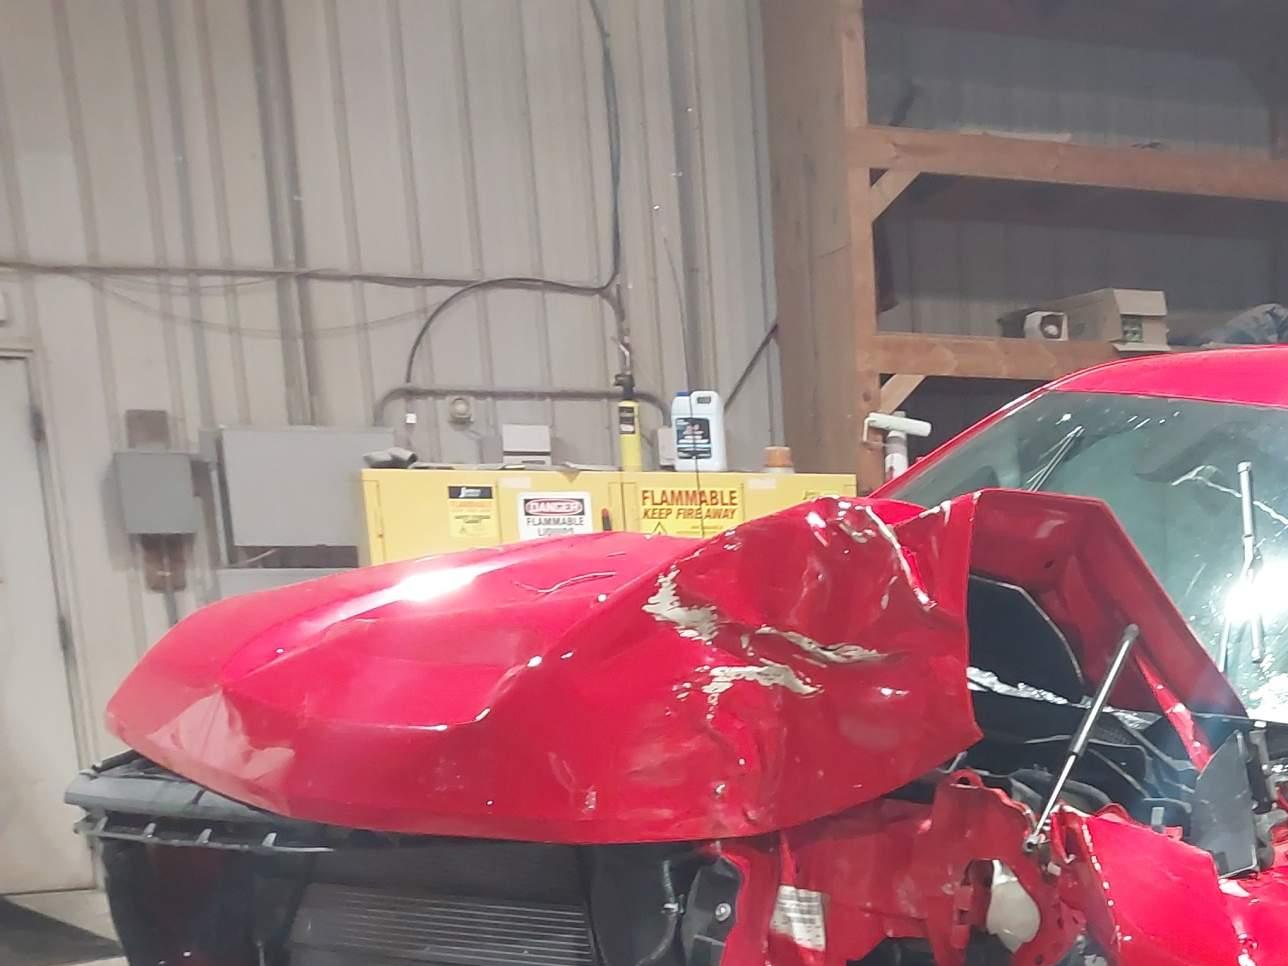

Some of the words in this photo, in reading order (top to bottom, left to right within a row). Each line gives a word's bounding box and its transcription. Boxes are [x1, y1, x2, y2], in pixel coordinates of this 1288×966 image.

[641, 489, 738, 506] FLAMMABLE
[530, 502, 579, 513] DANGER
[642, 508, 672, 519] KEEP
[676, 508, 703, 519] FIRE
[704, 508, 737, 519] AWAY
[526, 517, 585, 526] FLAMMABLE
